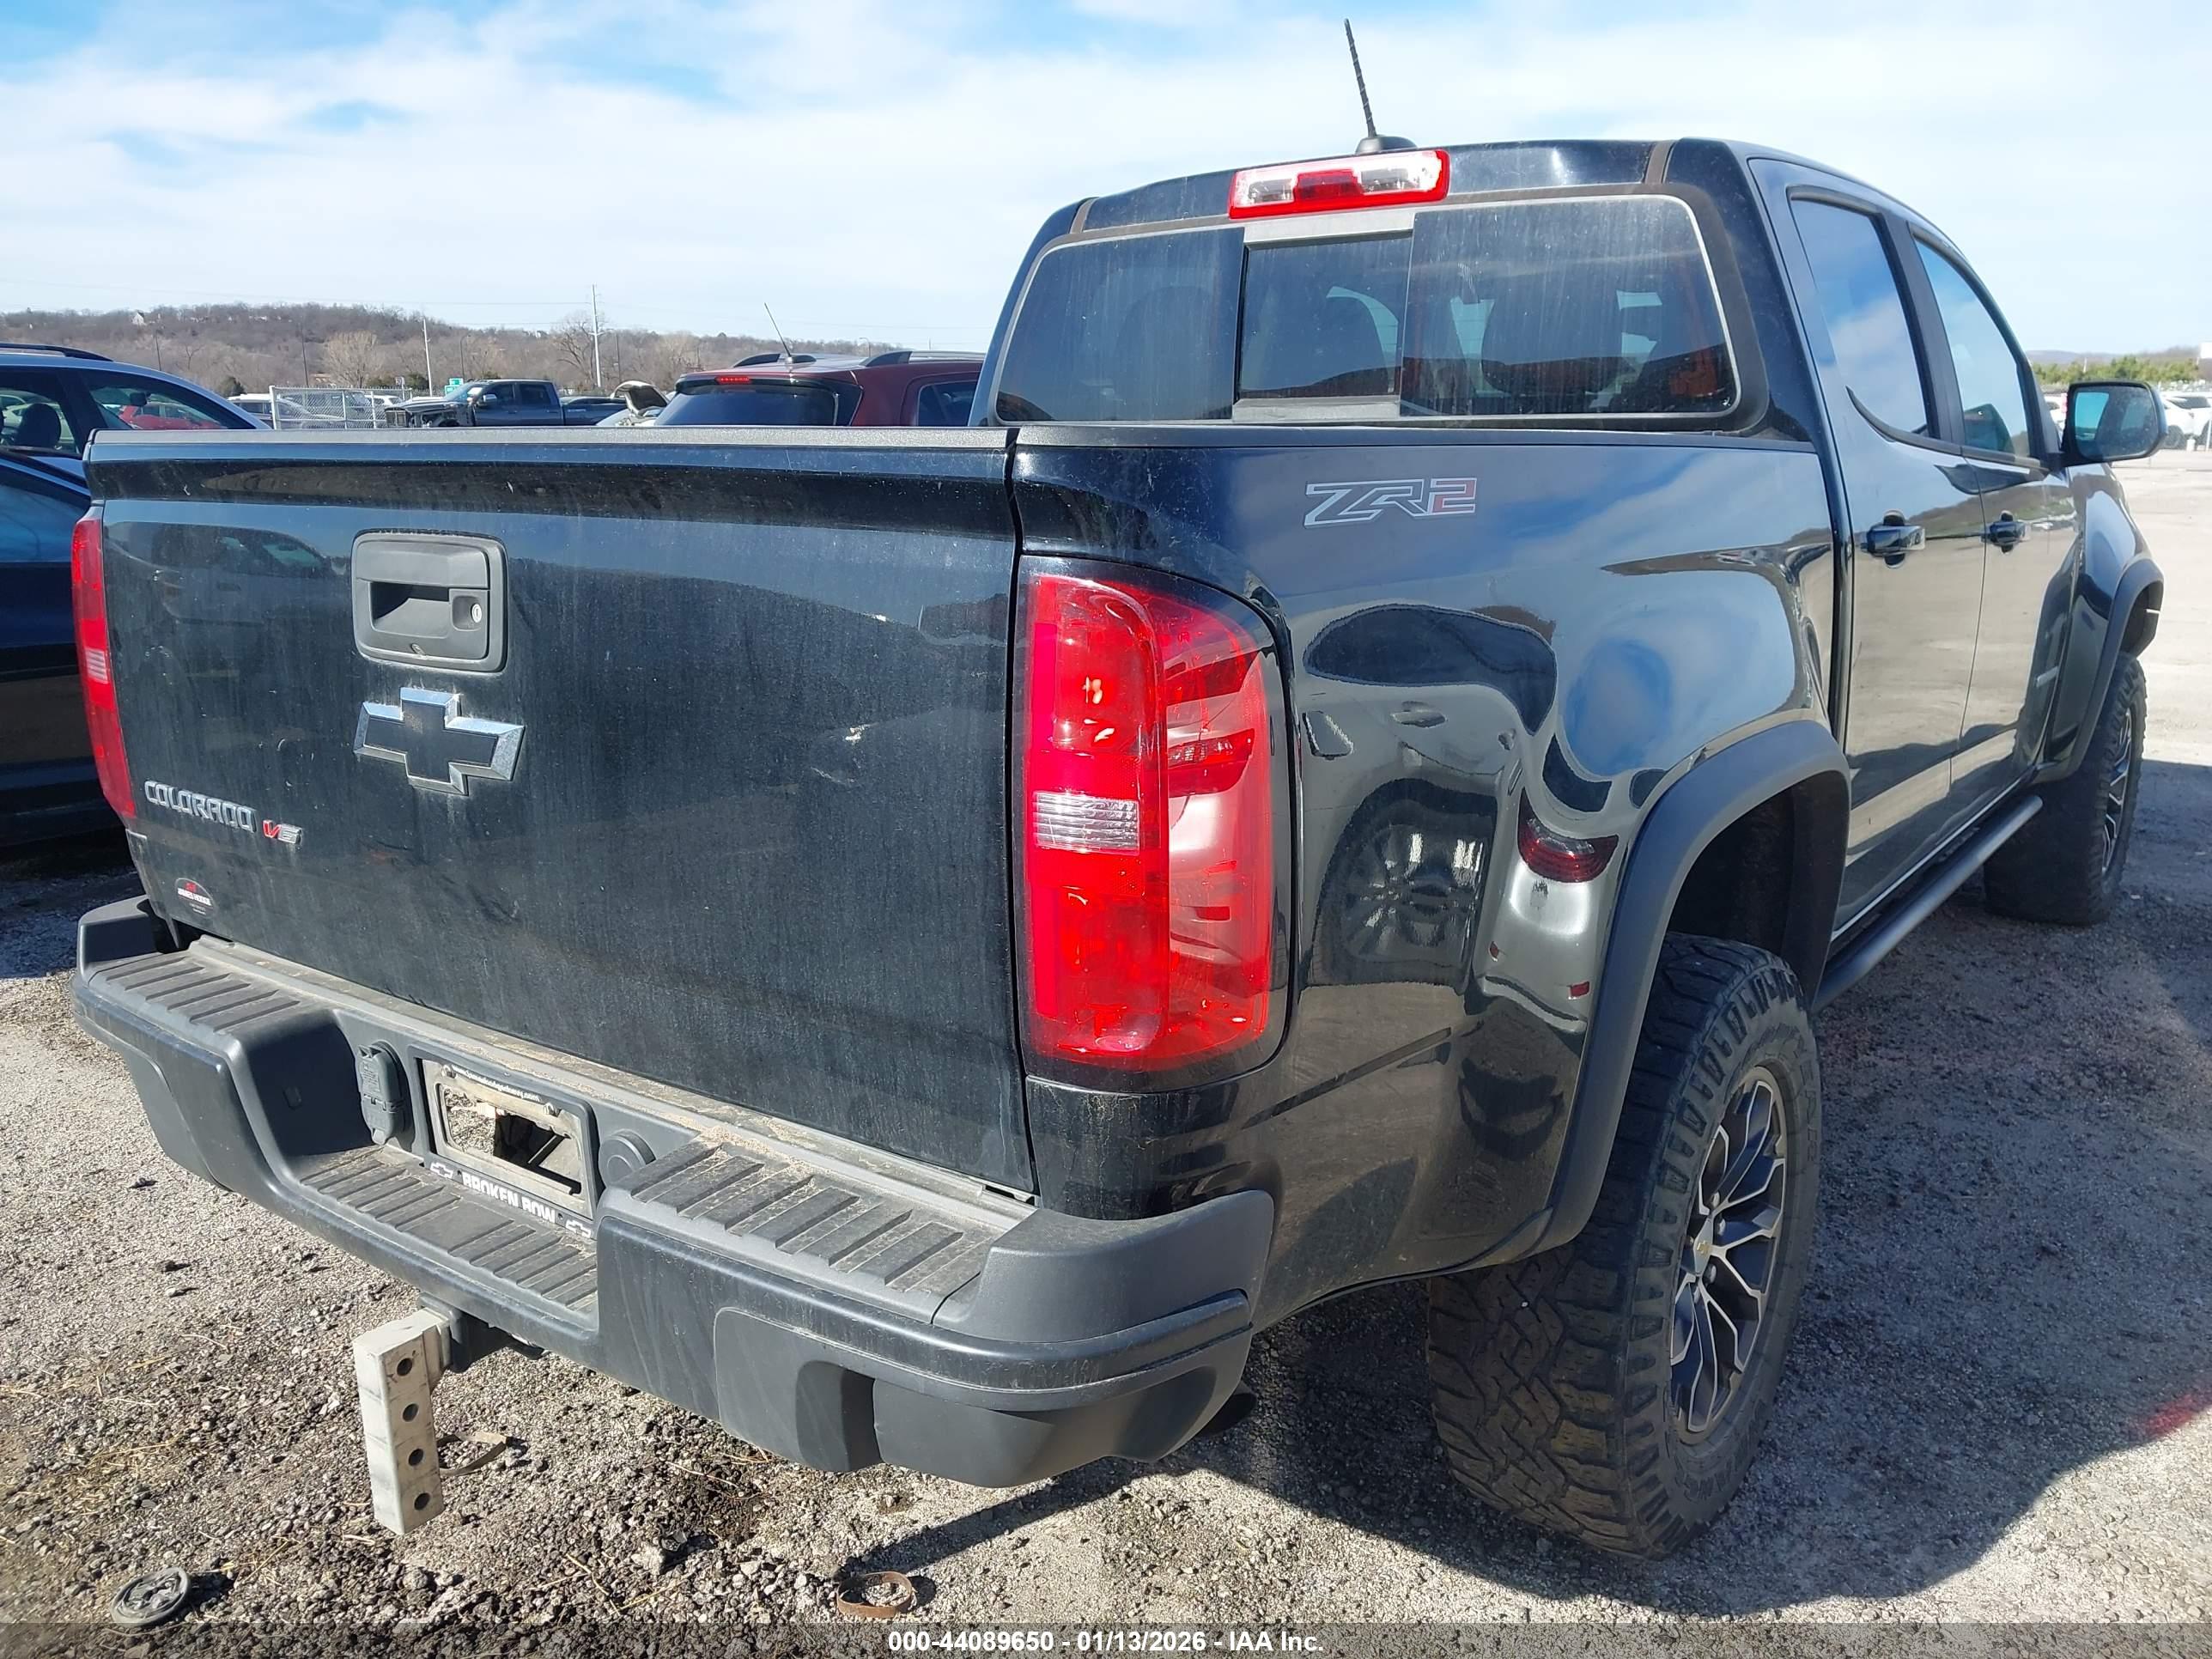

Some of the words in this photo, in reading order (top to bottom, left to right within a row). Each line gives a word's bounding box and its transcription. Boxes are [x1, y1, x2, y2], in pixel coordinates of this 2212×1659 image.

[1304, 477, 1478, 528] ZR2
[143, 780, 258, 833] COLORADO
[261, 819, 303, 845] V6
[461, 1171, 519, 1206] BROKEN
